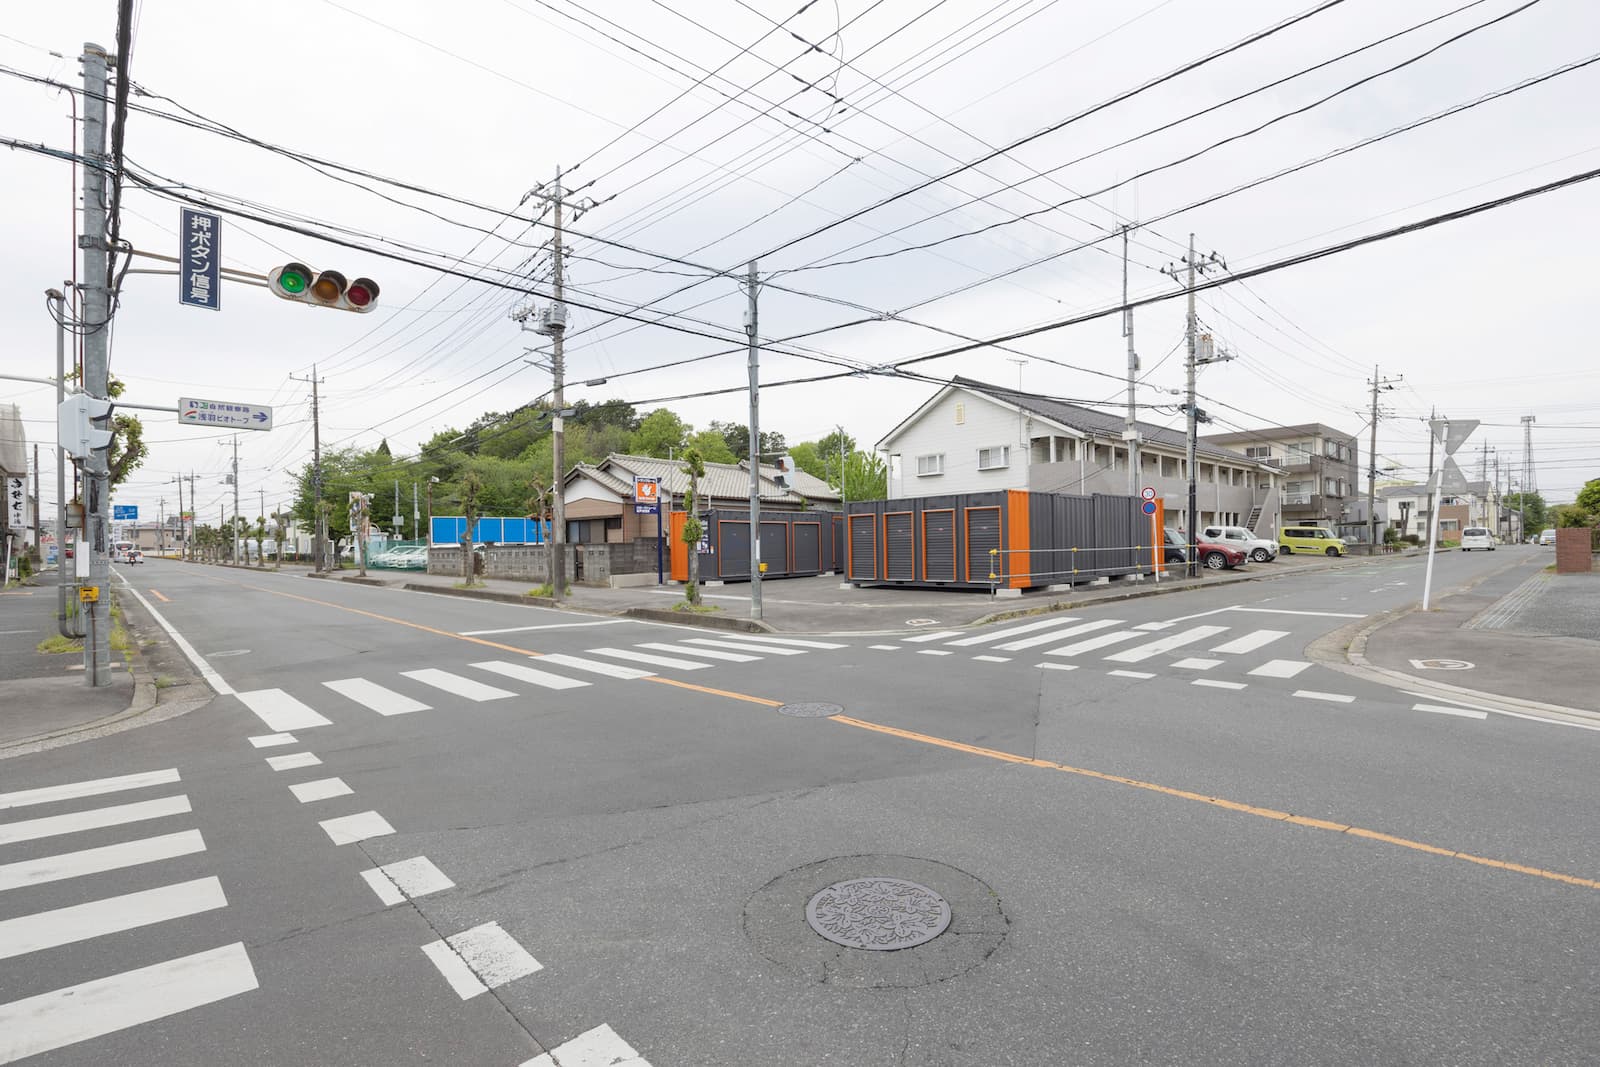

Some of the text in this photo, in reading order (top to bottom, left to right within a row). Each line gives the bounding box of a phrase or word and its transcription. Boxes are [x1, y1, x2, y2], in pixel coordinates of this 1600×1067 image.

[190, 214, 211, 304] 押ボタン信号
